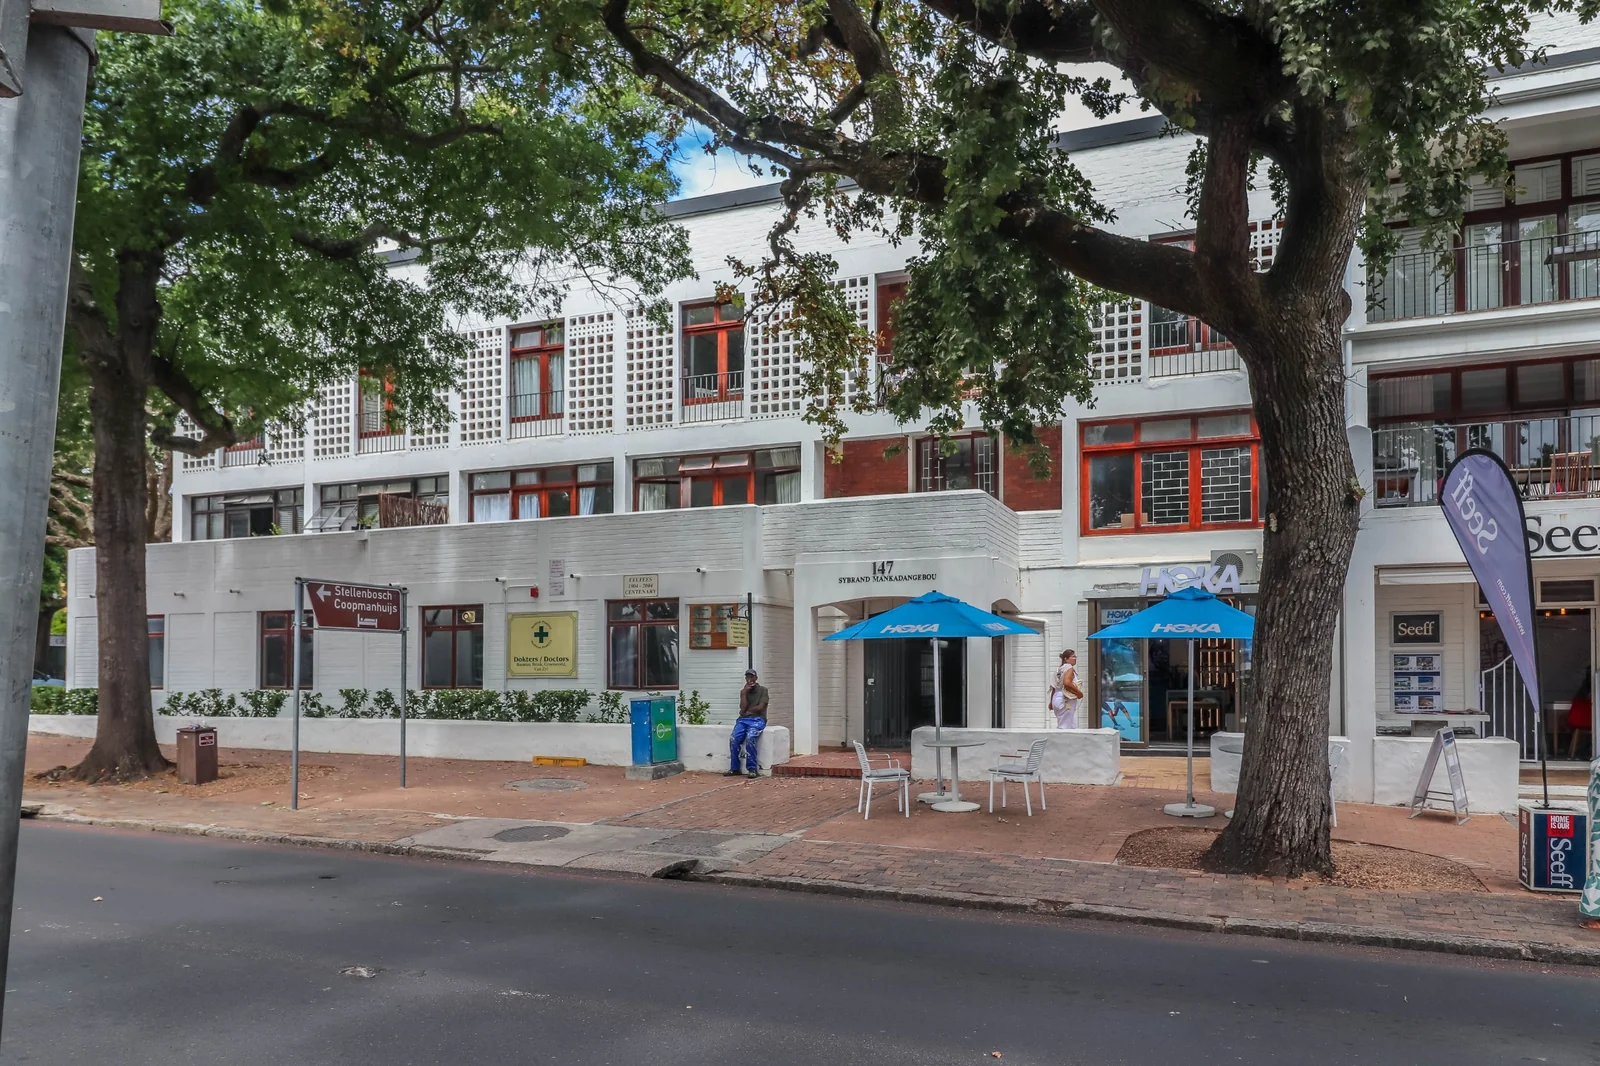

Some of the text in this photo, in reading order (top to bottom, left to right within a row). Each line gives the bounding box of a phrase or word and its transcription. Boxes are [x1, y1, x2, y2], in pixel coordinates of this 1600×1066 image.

[1525, 515, 1600, 554] See
[872, 561, 894, 575] 147
[838, 576, 871, 584] SYBRAND
[1140, 564, 1241, 596] HOKA
[334, 585, 393, 601] Stellenbosch
[334, 598, 398, 615] Coopmanhuijs
[880, 623, 940, 634] HOKA
[1151, 623, 1221, 633] HOKA
[1398, 621, 1435, 636] Seeff
[1550, 815, 1570, 823] HOME
[1550, 837, 1574, 889] Seeff
